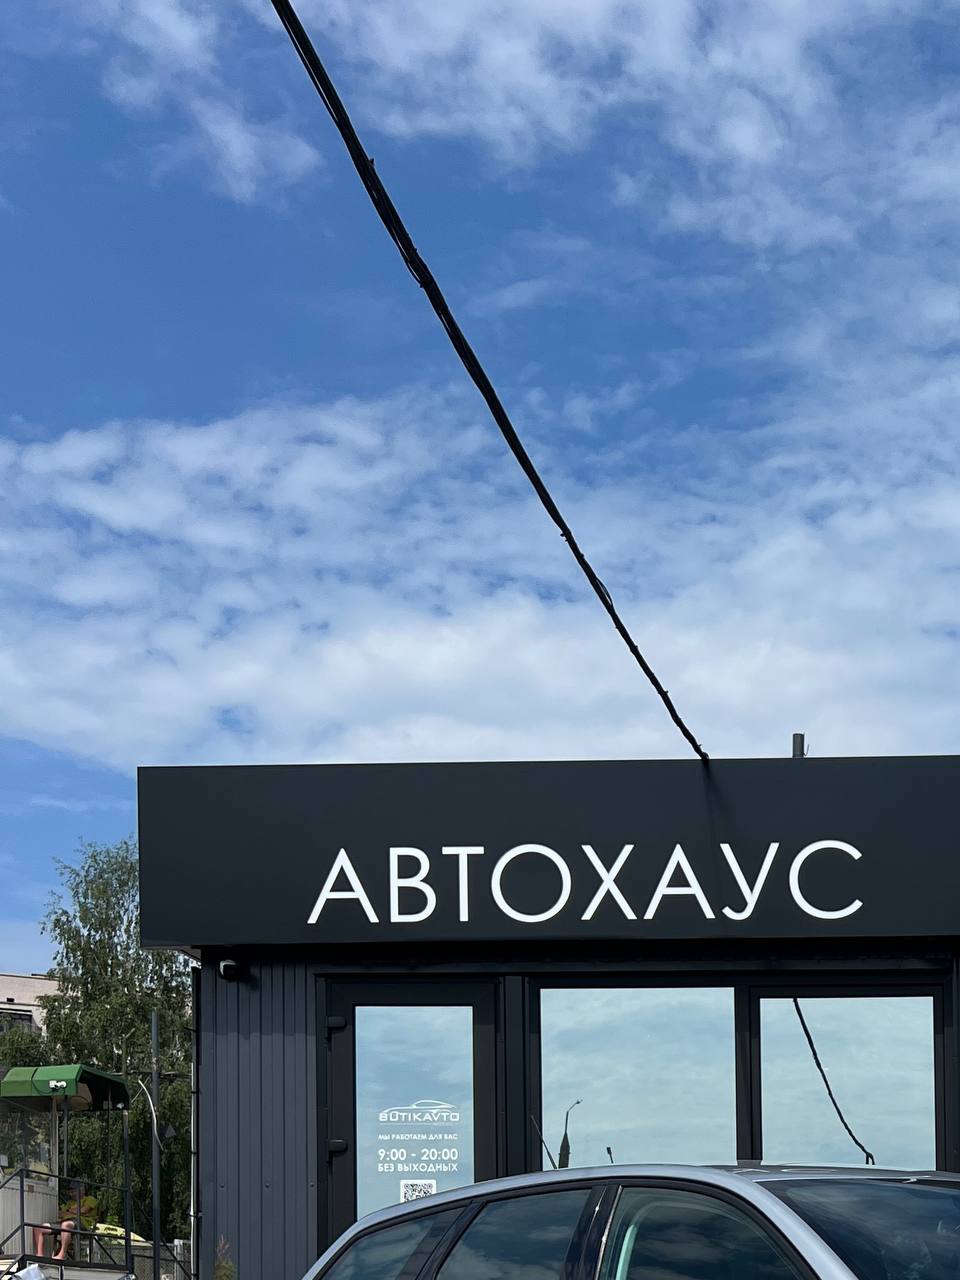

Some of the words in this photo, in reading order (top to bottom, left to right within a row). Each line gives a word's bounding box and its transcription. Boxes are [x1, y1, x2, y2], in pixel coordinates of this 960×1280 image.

[307, 839, 864, 925] АВТОХАУС
[379, 1111, 460, 1121] BUTIKAVTO
[378, 1148, 407, 1161] 9:00
[420, 1148, 459, 1161] 20:00
[378, 1163, 395, 1172] БЕЗ
[397, 1163, 458, 1173] ВЫХОДНЫХ
